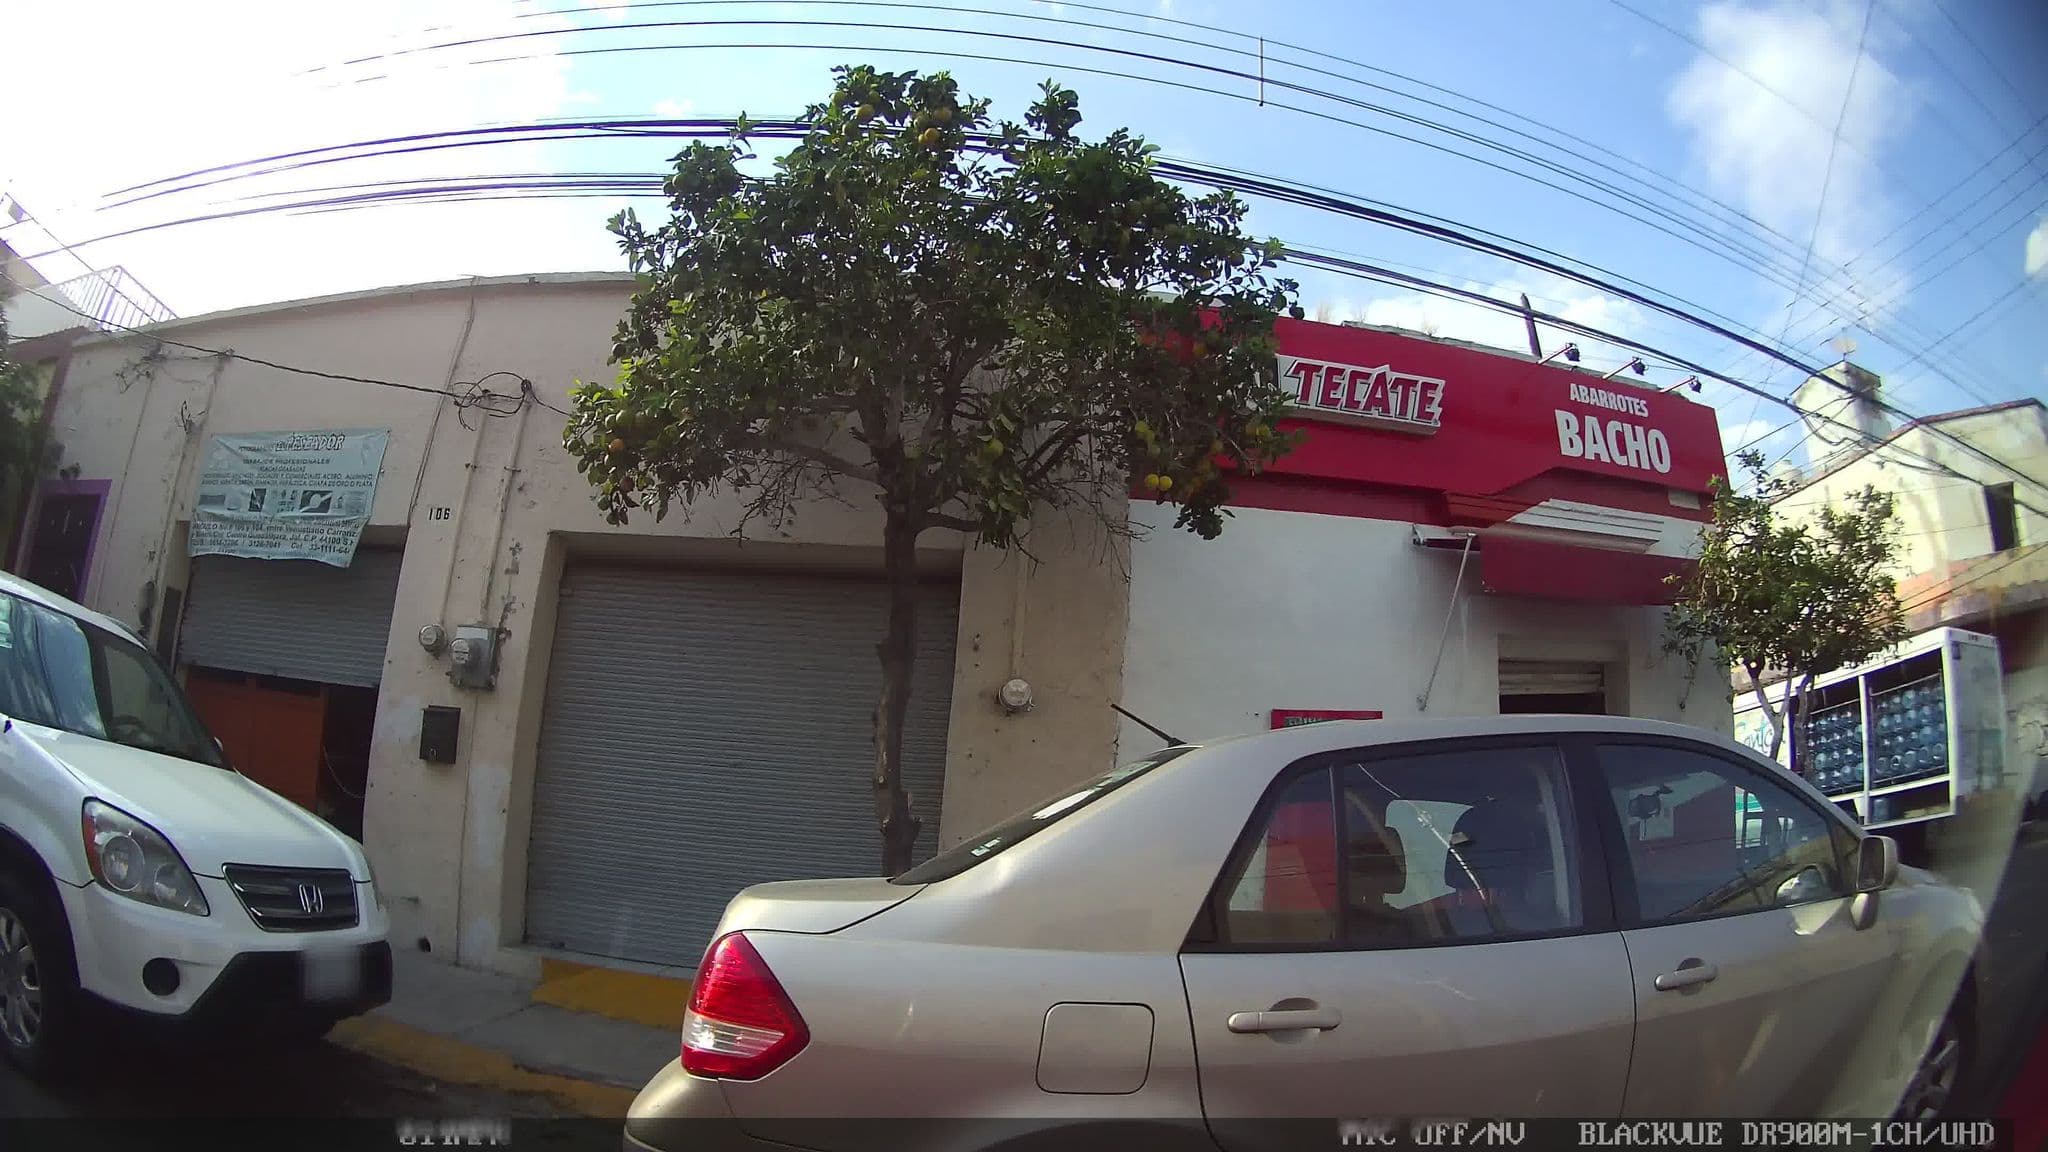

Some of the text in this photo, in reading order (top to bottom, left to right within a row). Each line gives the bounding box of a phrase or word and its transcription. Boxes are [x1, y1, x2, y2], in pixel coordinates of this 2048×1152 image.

[1285, 360, 1440, 425] TECATE
[1569, 383, 1649, 418] ABARROTES
[1554, 409, 1671, 474] BACHO
[429, 507, 451, 521] 106
